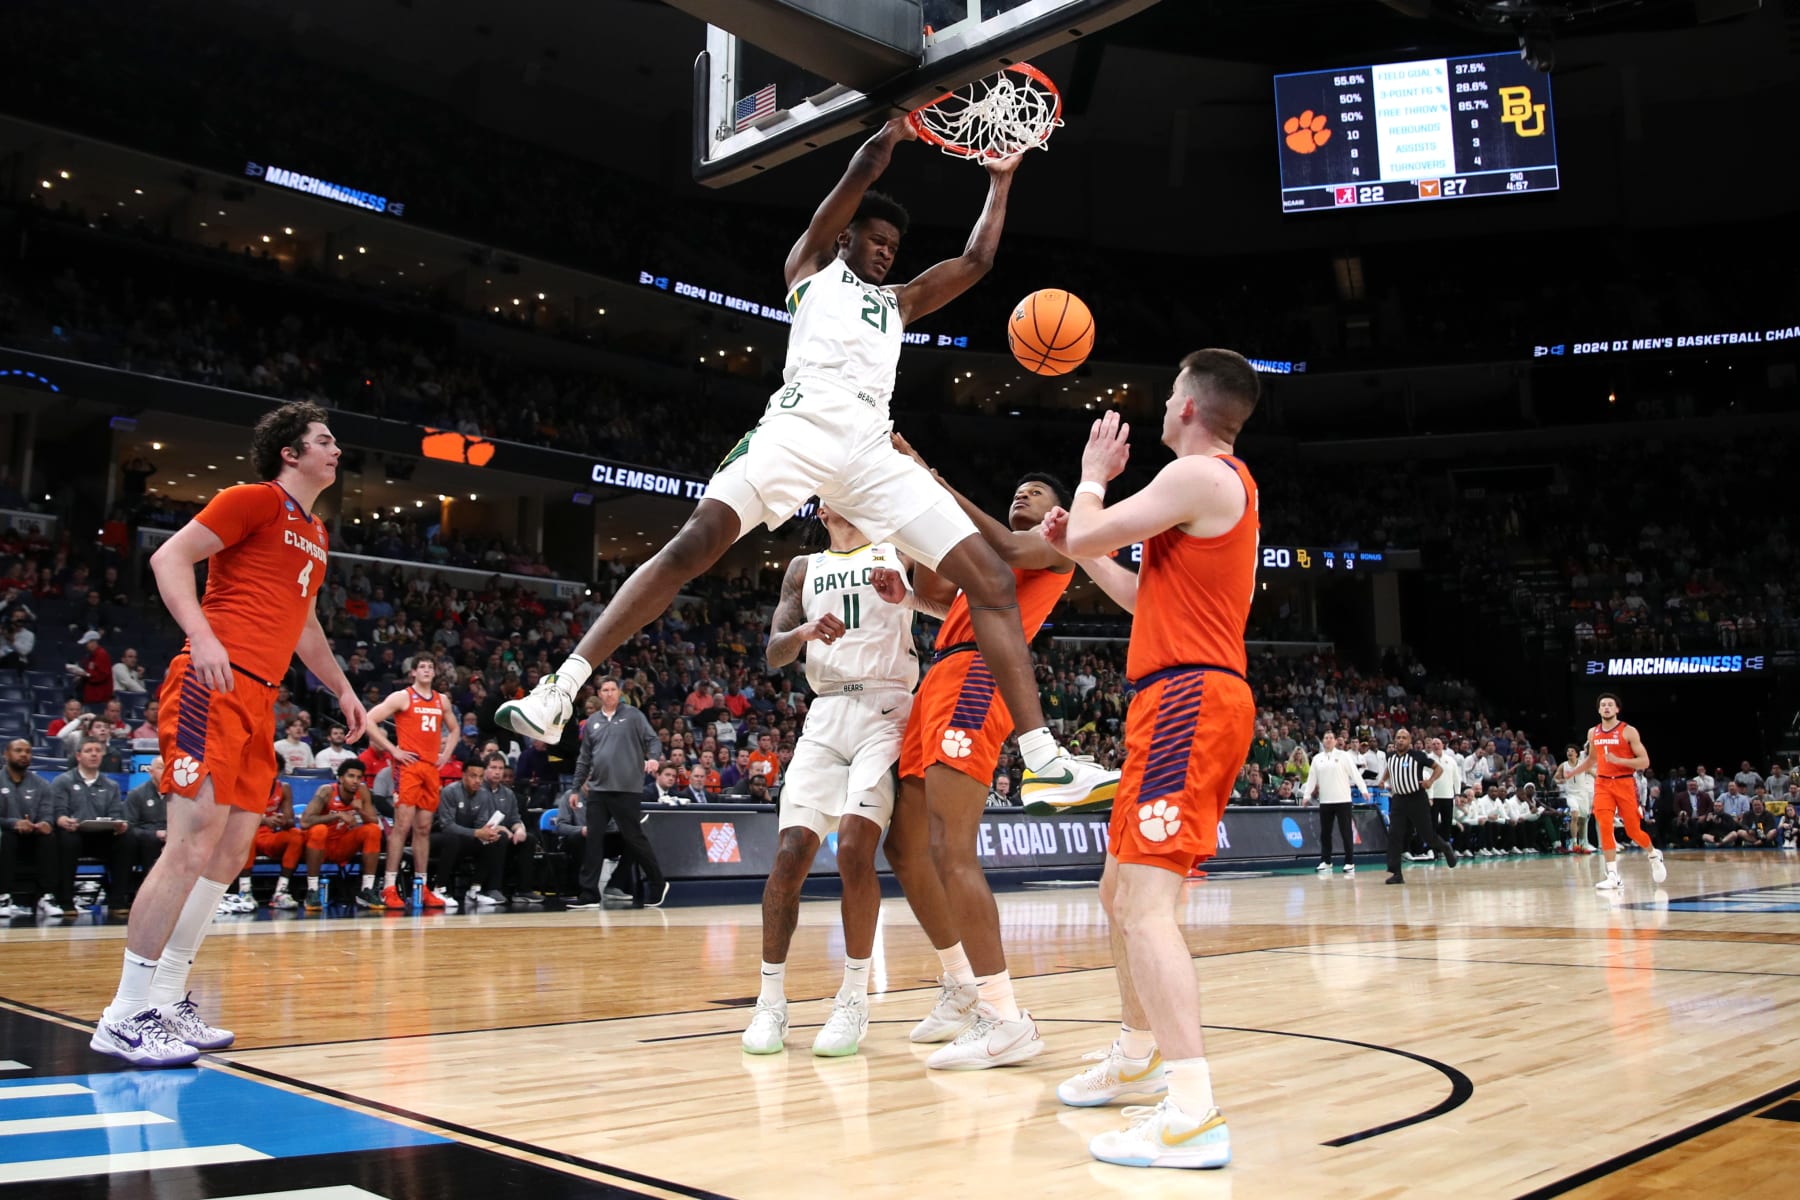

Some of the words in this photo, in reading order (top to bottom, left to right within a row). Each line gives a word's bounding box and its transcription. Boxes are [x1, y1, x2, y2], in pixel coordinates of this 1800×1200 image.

[1378, 71, 1405, 81] FIELD
[1407, 68, 1432, 78] GOAL
[1434, 66, 1443, 75] %
[1455, 63, 1486, 74] 37.5%
[1334, 75, 1365, 86] 55.6%
[1456, 81, 1488, 93] 28.6%
[1340, 94, 1362, 104] 50%
[1380, 88, 1420, 99] 3-POINT
[1435, 85, 1444, 94] %
[1378, 108, 1401, 118] FREE
[1404, 105, 1438, 116] THROW
[1440, 103, 1449, 112] %
[1458, 100, 1489, 111] 85.7%
[1341, 112, 1363, 122] 50%
[1347, 130, 1360, 140] 10
[1389, 122, 1441, 136] REBOUNDS
[1395, 142, 1437, 154] ASSISTS
[1472, 138, 1480, 147] 3
[1389, 159, 1446, 173] TURNOVERS
[1474, 156, 1482, 165] 4
[1352, 167, 1360, 176] 4
[1510, 172, 1524, 181] 2ND
[1443, 179, 1467, 195] 27
[1506, 181, 1528, 190] 4:57
[1359, 186, 1385, 202] 22
[674, 281, 706, 300] 2024
[708, 291, 724, 304] DI
[725, 296, 760, 315] MEN'S
[861, 294, 888, 334] 21
[1573, 341, 1608, 354] 2024
[1612, 341, 1629, 351] DI
[1632, 337, 1673, 350] MEN'S
[1677, 332, 1762, 347] BASKETBALL
[857, 390, 877, 407] BEARS
[592, 464, 681, 496] CLEMSON
[284, 529, 328, 566] CLEMSON
[1263, 549, 1290, 567] 20
[1326, 559, 1333, 568] 4
[1346, 560, 1353, 569] 3
[297, 559, 314, 598] 4
[814, 566, 886, 594] BAYLO
[843, 594, 860, 630] 11
[843, 684, 864, 692] BEARS
[421, 715, 437, 732] 24
[998, 822, 1058, 856] ROAD
[1059, 822, 1089, 854] TO
